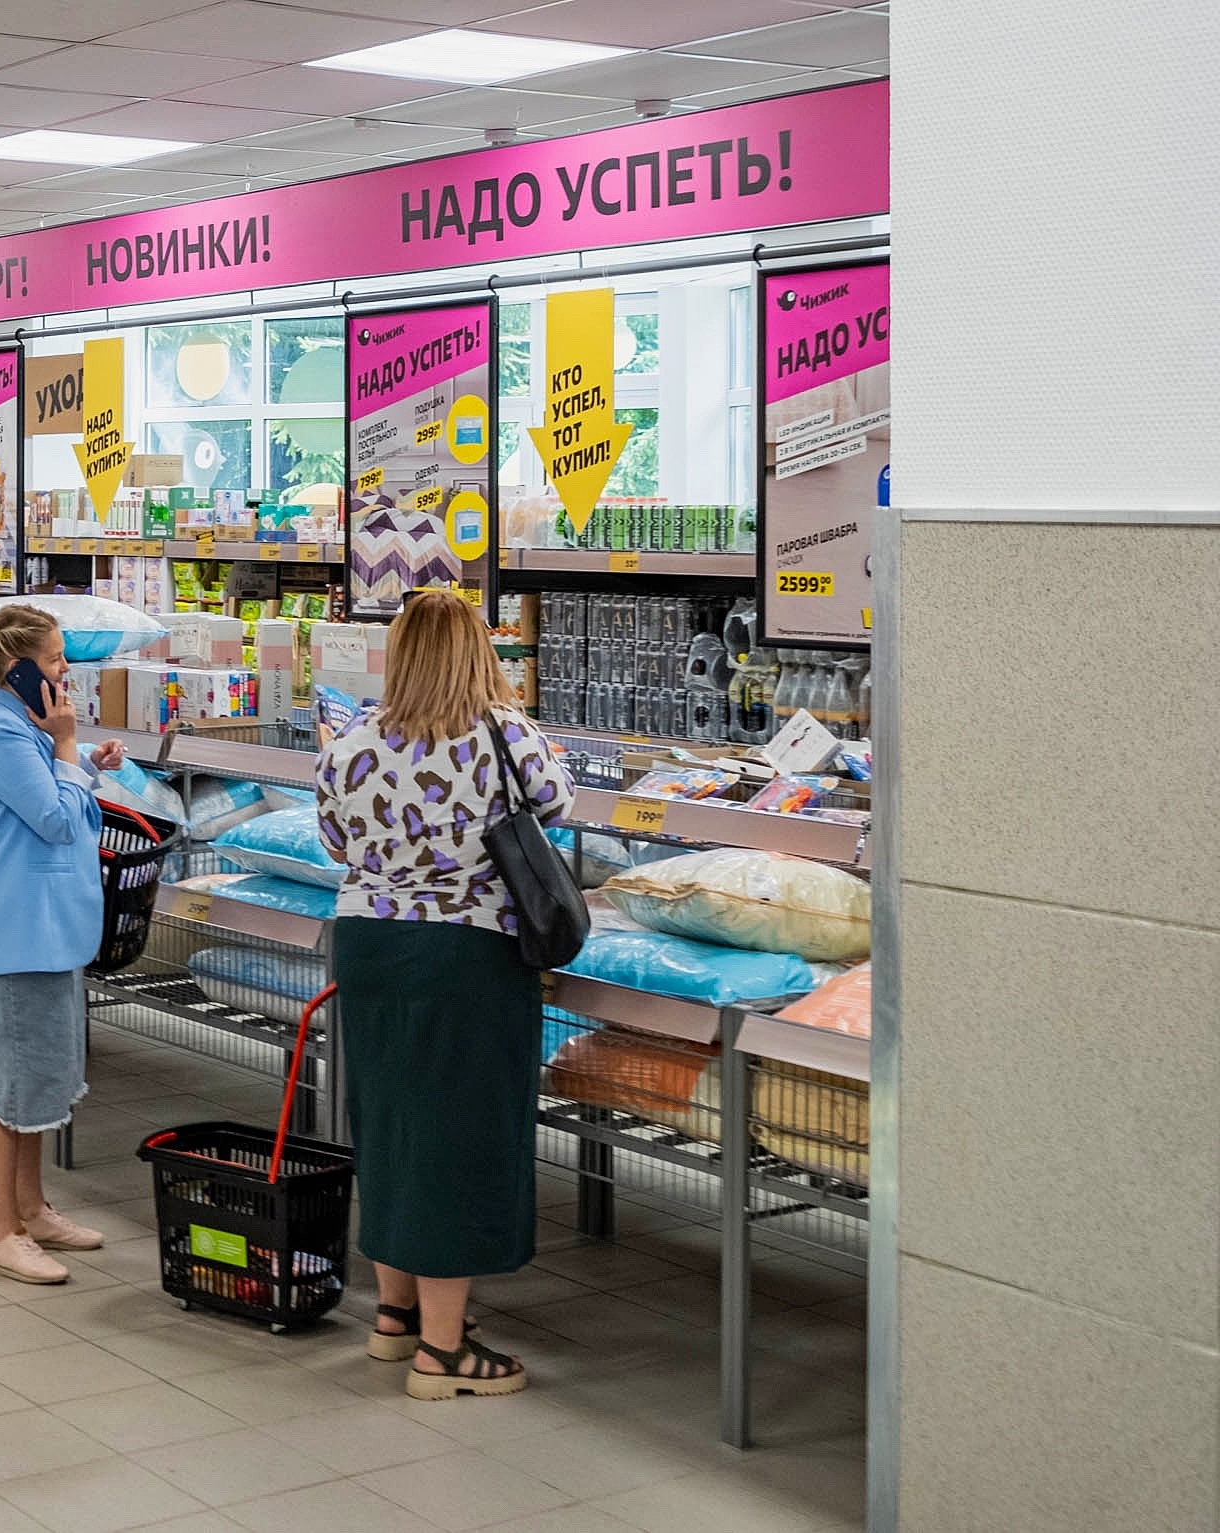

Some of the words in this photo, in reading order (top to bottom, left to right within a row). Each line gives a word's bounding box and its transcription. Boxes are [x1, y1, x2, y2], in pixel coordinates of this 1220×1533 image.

[401, 172, 541, 245] НАДО
[556, 130, 792, 222] УСПЕТЬ!
[85, 214, 270, 286] НОВИНКИ!
[800, 283, 849, 311] Чижик
[778, 322, 849, 379] НАДО
[855, 306, 891, 349] УС
[357, 356, 406, 401] НАДО
[409, 320, 481, 377] УСПЕТЬ!
[552, 364, 582, 394] КТО
[415, 396, 445, 416] ПОДУШКА
[552, 385, 606, 423] УСПЕЛ,
[86, 409, 113, 435] НАДО
[416, 427, 434, 443] 299
[553, 421, 582, 450] ТОТ
[86, 429, 120, 457] УСПЕТЬ
[86, 447, 127, 479] КУПИТЬ!
[552, 439, 610, 480] КУПИЛ!
[360, 473, 376, 488] 799
[416, 492, 434, 508] 599
[776, 533, 819, 556] ПАРОВАЯ
[820, 521, 858, 543] ШВАБРА
[780, 576, 819, 593] 2599
